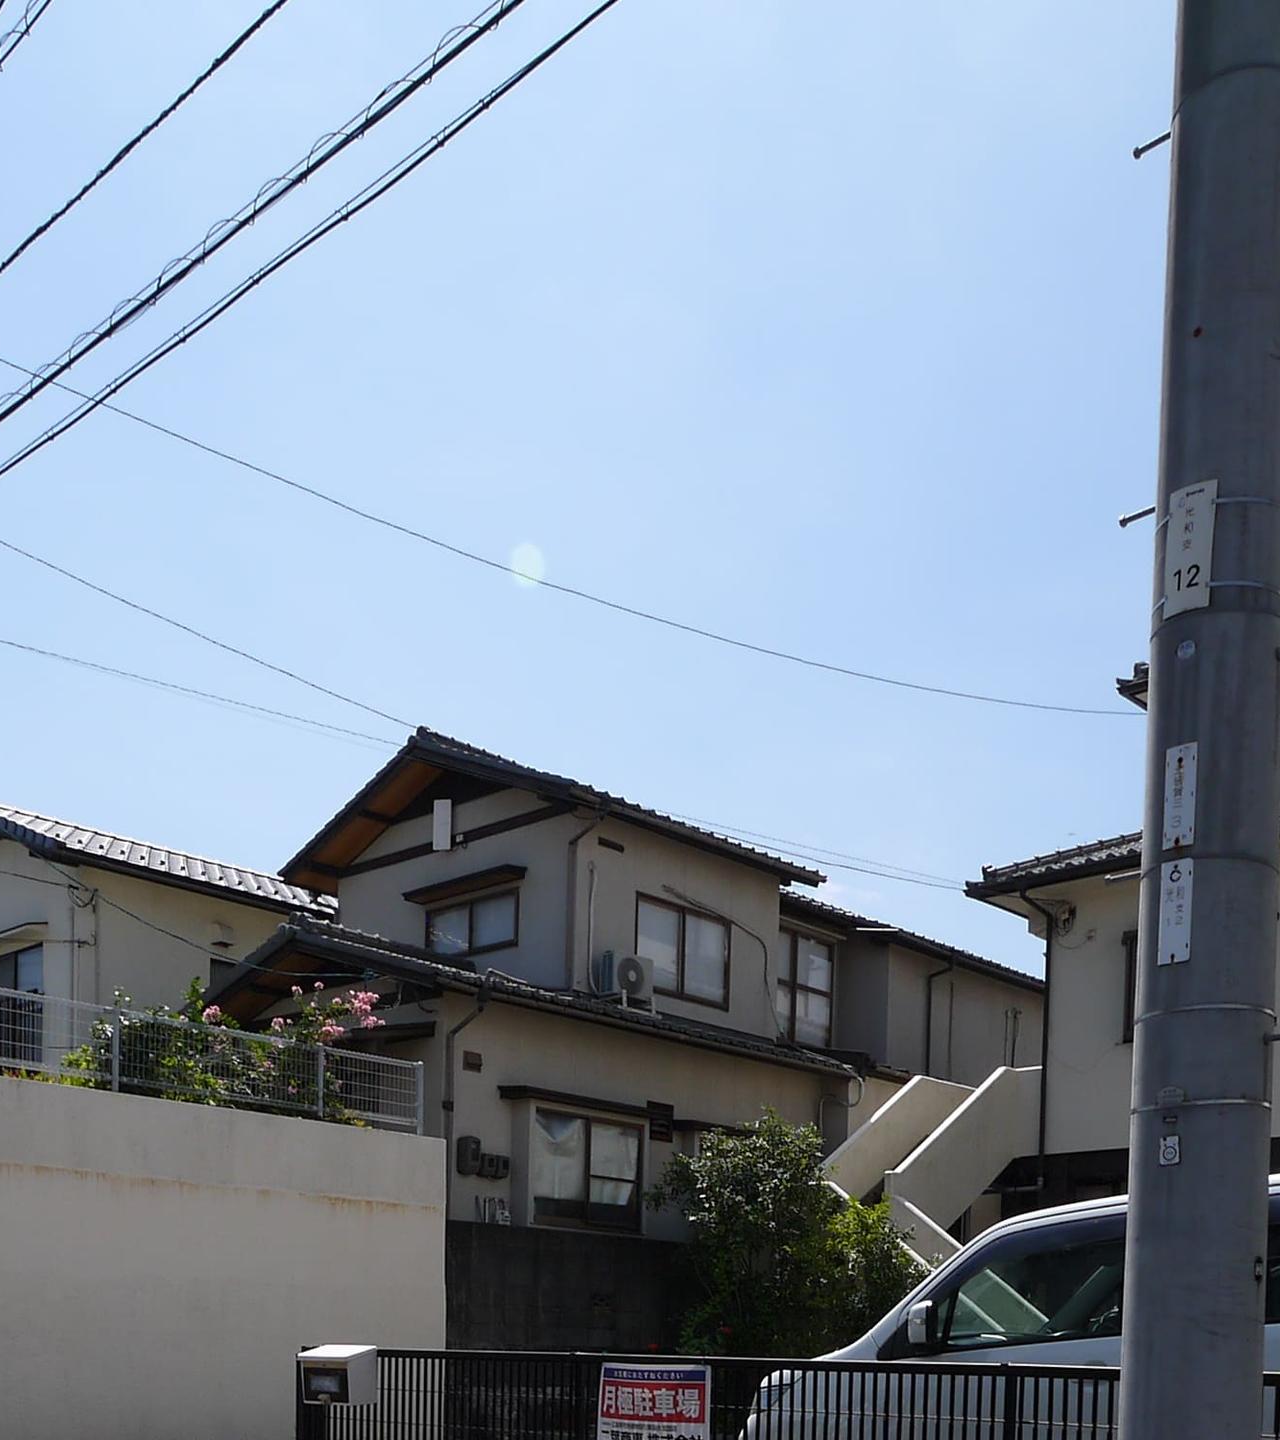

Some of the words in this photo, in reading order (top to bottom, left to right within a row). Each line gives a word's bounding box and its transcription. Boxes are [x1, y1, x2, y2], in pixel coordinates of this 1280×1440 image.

[1173, 564, 1200, 591] 12
[603, 1385, 701, 1418] 月極駐車場
